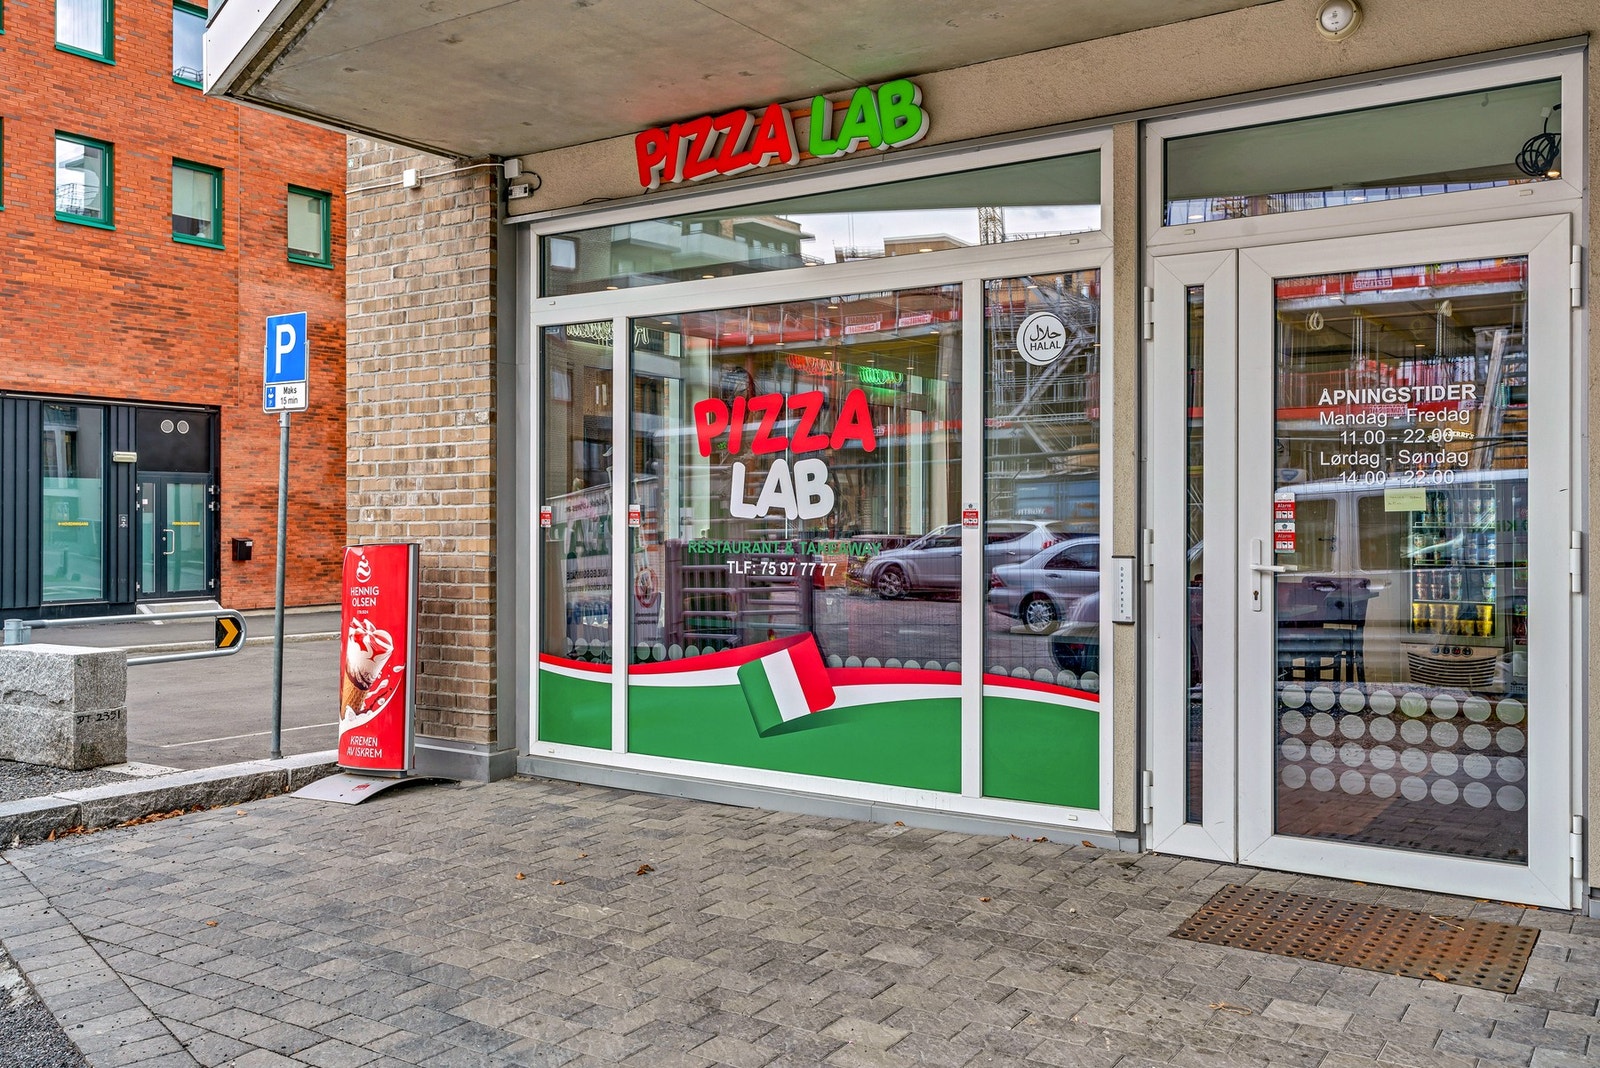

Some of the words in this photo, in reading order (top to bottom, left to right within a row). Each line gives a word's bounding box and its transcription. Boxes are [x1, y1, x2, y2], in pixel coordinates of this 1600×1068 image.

[635, 103, 799, 189] PIZZA
[809, 79, 930, 158] LAB
[1030, 324, 1062, 341] حلال
[275, 323, 297, 374] P
[1030, 341, 1061, 351] HALAL
[283, 386, 297, 395] Maks
[1318, 384, 1477, 405] ÅPNINGSTIDER
[281, 396, 287, 405] 15
[288, 396, 299, 405] min
[694, 388, 877, 457] PIZZA
[1320, 411, 1387, 427] Mandag
[1407, 407, 1470, 425] Fredag
[1340, 430, 1385, 445] 11.00
[1403, 428, 1453, 444] 22.00
[1320, 451, 1380, 468] Lørdag
[1398, 449, 1469, 467] Søndag
[1339, 471, 1386, 485] 14.00
[1404, 470, 1454, 484] 22.00
[730, 458, 835, 520] LAB
[688, 540, 781, 554] RESTAURANT
[784, 541, 795, 555] &
[799, 541, 881, 556] TAKEAWAY
[727, 561, 756, 574] TLF:
[761, 562, 776, 575] 75
[780, 562, 796, 576] 97
[801, 563, 816, 576] 77
[821, 563, 837, 577] 77
[350, 586, 379, 596] HENNIG
[352, 597, 377, 607] OLSEN
[350, 735, 378, 747] KREMEN
[346, 746, 355, 756] AV
[355, 747, 382, 758] ISKREM
